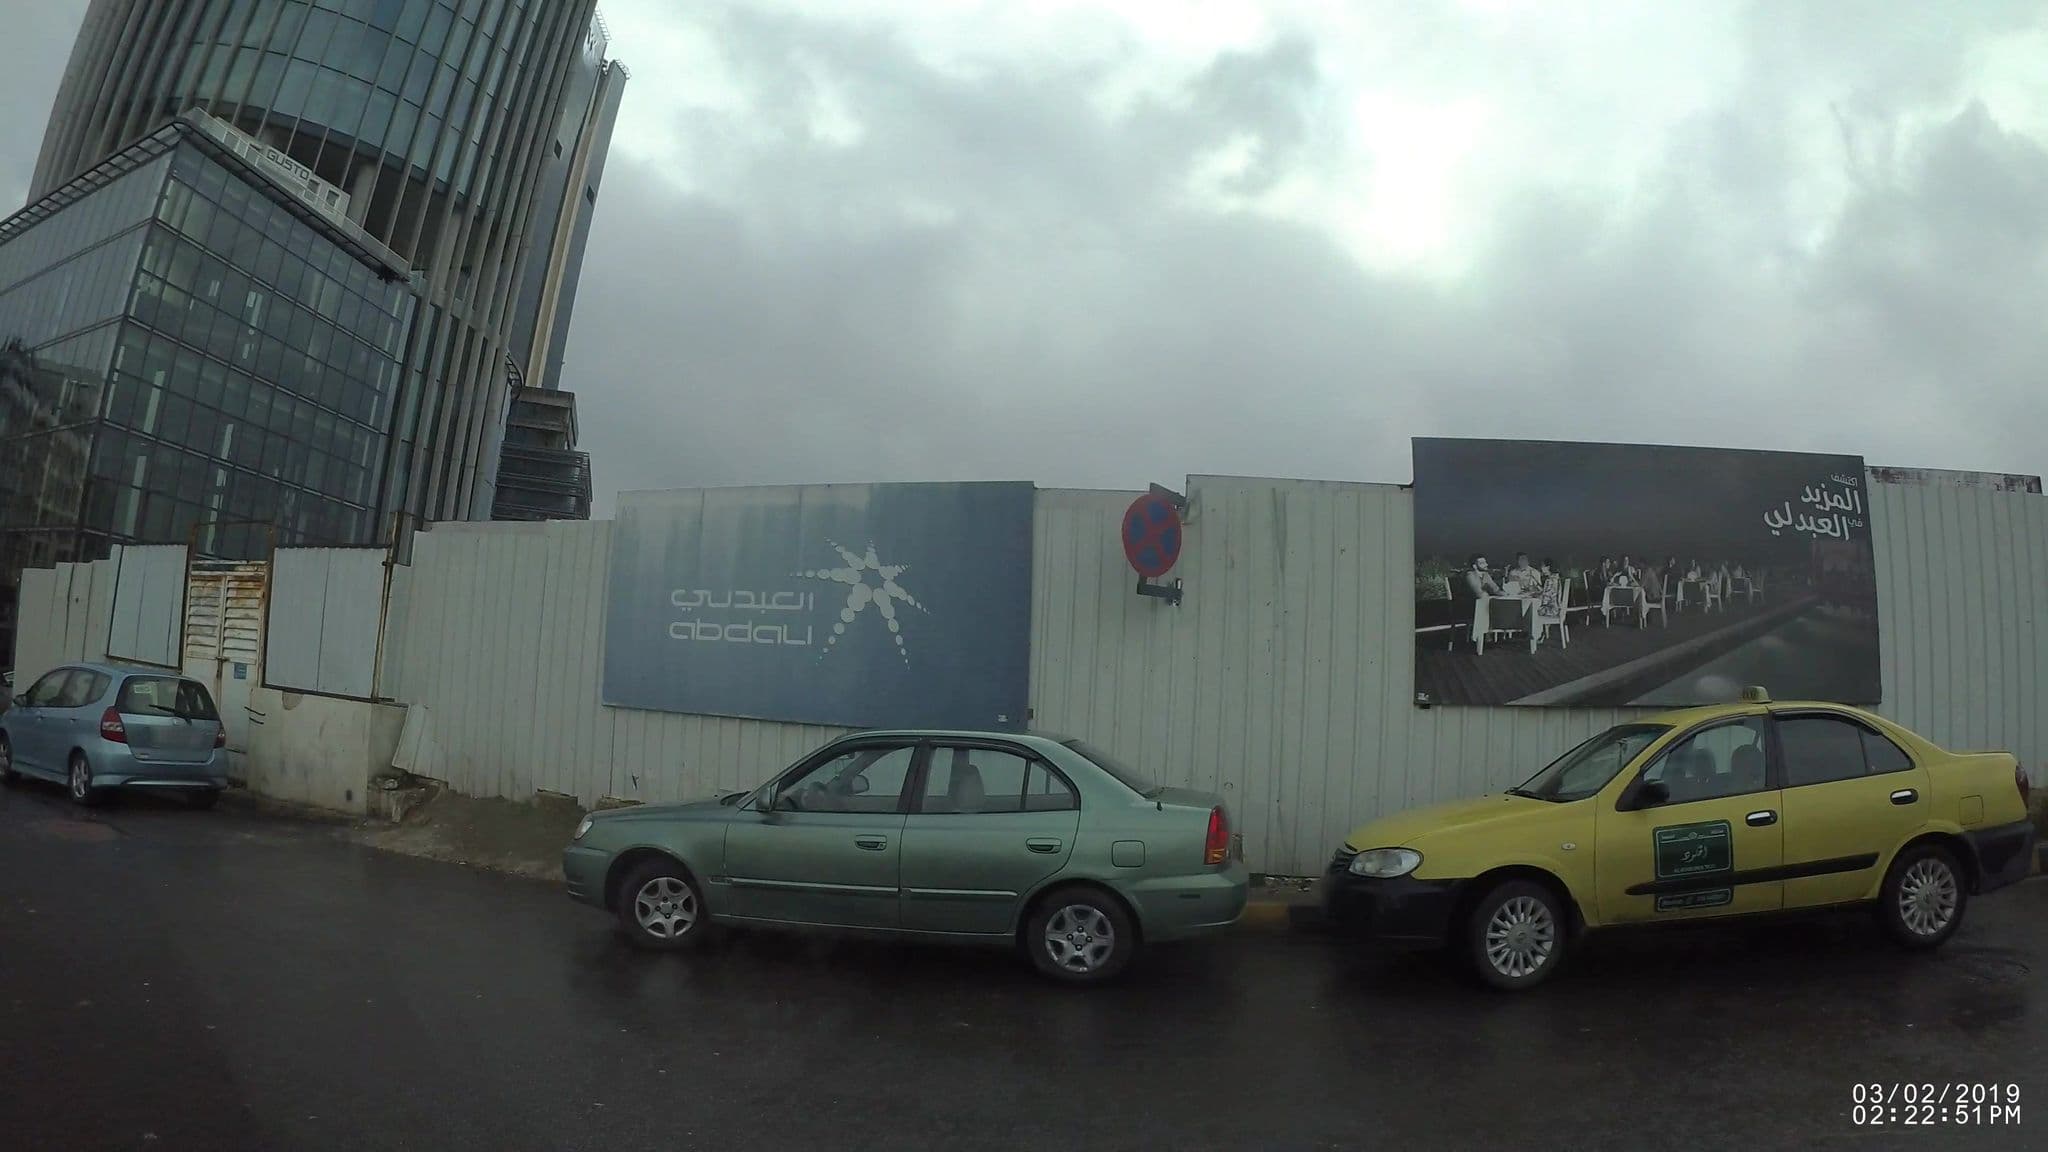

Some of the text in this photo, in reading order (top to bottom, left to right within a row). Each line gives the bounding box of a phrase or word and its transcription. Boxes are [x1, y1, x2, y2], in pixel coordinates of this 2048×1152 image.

[266, 151, 310, 181] GUSTO
[1801, 482, 1861, 514] المزيد
[1763, 501, 1863, 541] في العبدلي
[671, 589, 814, 614] العبدلي
